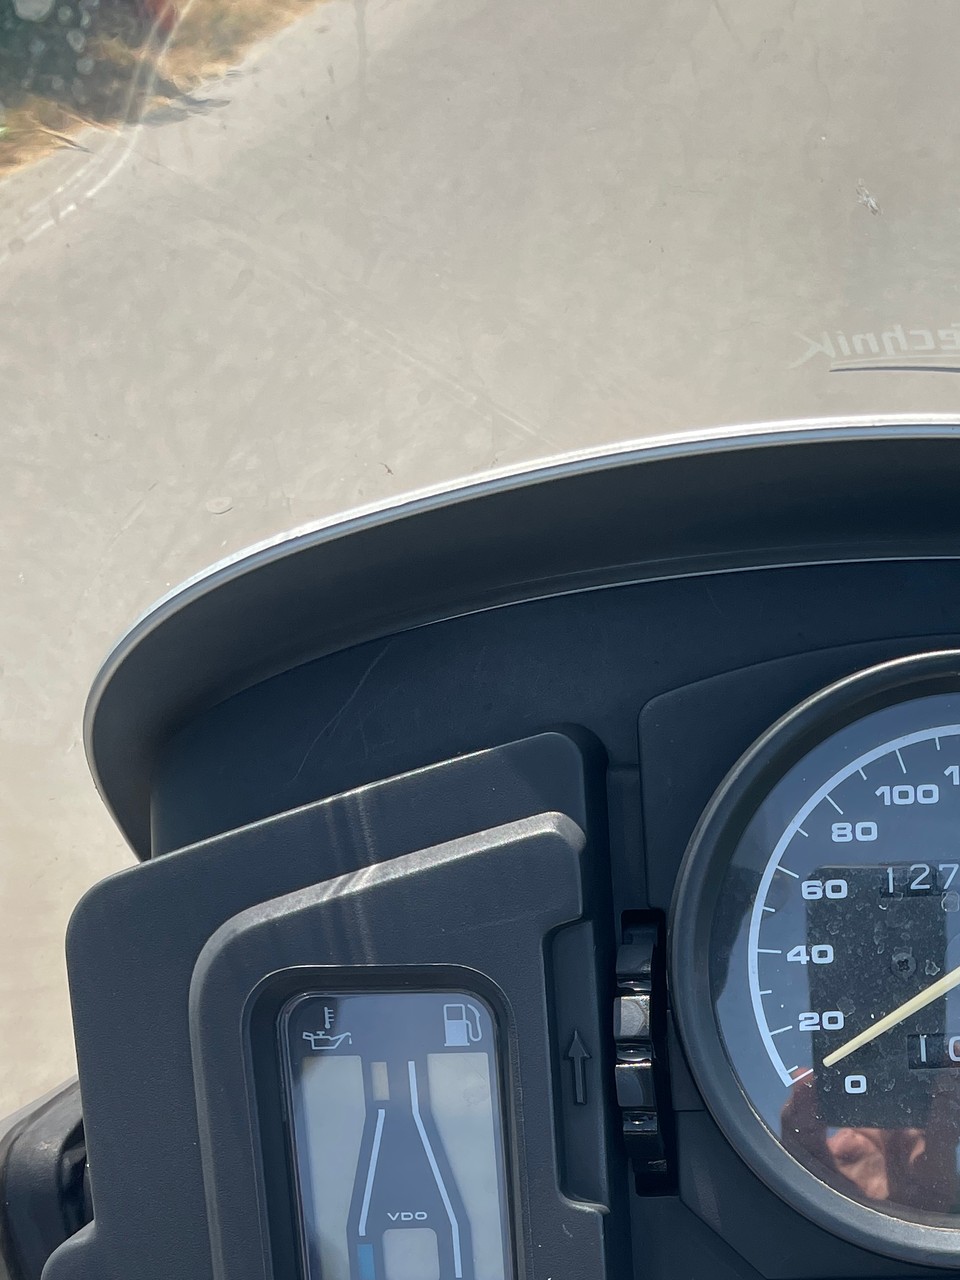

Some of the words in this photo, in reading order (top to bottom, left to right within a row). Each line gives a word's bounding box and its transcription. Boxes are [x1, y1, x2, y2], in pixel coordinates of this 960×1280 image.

[875, 784, 940, 805] 100
[830, 822, 878, 842] 80
[800, 879, 848, 900] 60
[786, 944, 834, 964] 40
[798, 1011, 845, 1031] 20
[844, 1075, 866, 1094] 0
[387, 1211, 428, 1220] VDO
